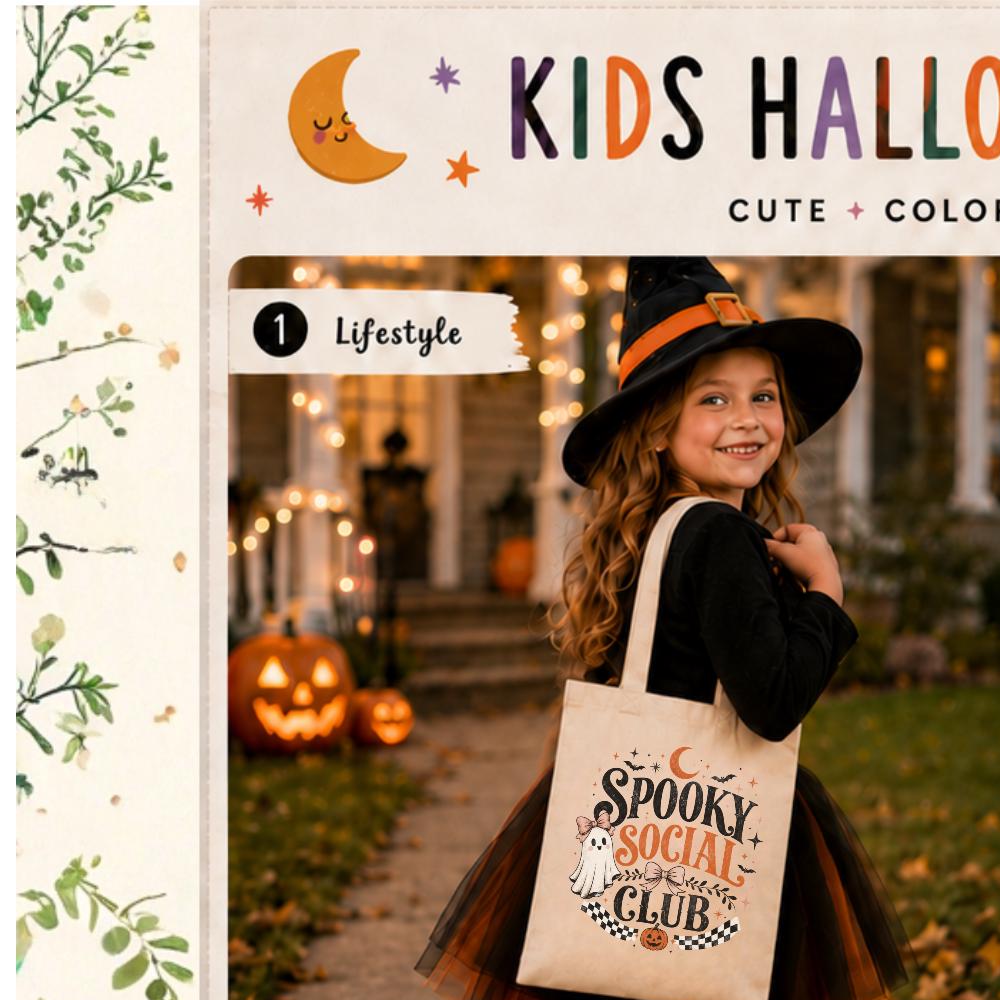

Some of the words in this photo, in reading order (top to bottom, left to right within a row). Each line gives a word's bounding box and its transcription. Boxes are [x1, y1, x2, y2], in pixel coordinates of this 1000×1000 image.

[593, 767, 760, 844] SPOOKY
[614, 823, 745, 888] SOCIAL
[613, 885, 711, 932] CLUB
